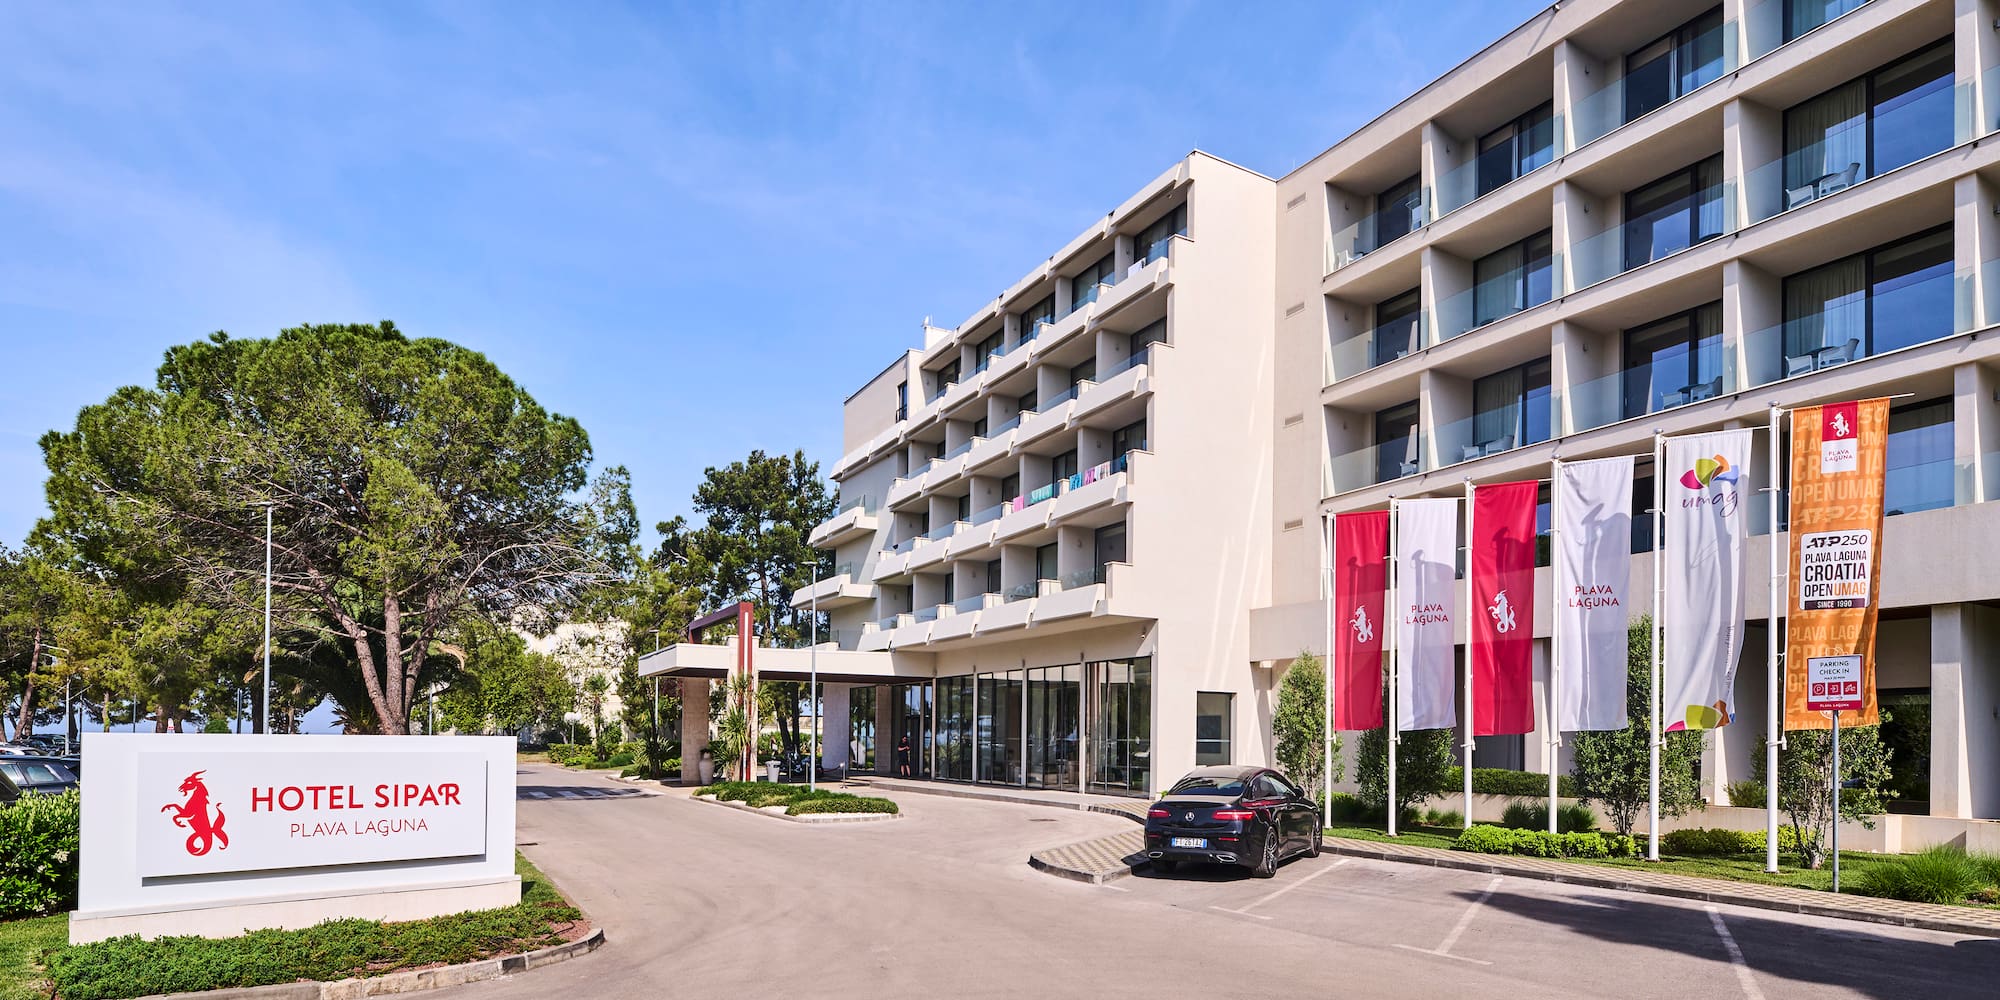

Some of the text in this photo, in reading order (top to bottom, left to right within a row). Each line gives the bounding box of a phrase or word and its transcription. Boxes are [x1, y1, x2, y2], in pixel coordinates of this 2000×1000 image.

[1824, 454, 1853, 462] LAGUNA
[1682, 490, 1738, 518] umag
[1805, 550, 1867, 564] PLAVA LAGUNA
[1804, 562, 1866, 582] CROATIA
[1575, 585, 1613, 596] PLAVA
[1411, 603, 1444, 613] PLAVA
[1569, 597, 1619, 610] LAGUNA
[1817, 599, 1852, 609] SINCE 1990
[1406, 614, 1449, 626] LAGUNA
[1790, 625, 1827, 642] PLAVA
[1819, 668, 1841, 676] CHECK
[251, 783, 462, 813] HOTEL SIPAR
[290, 818, 428, 838] PLAVA LAGUNA
